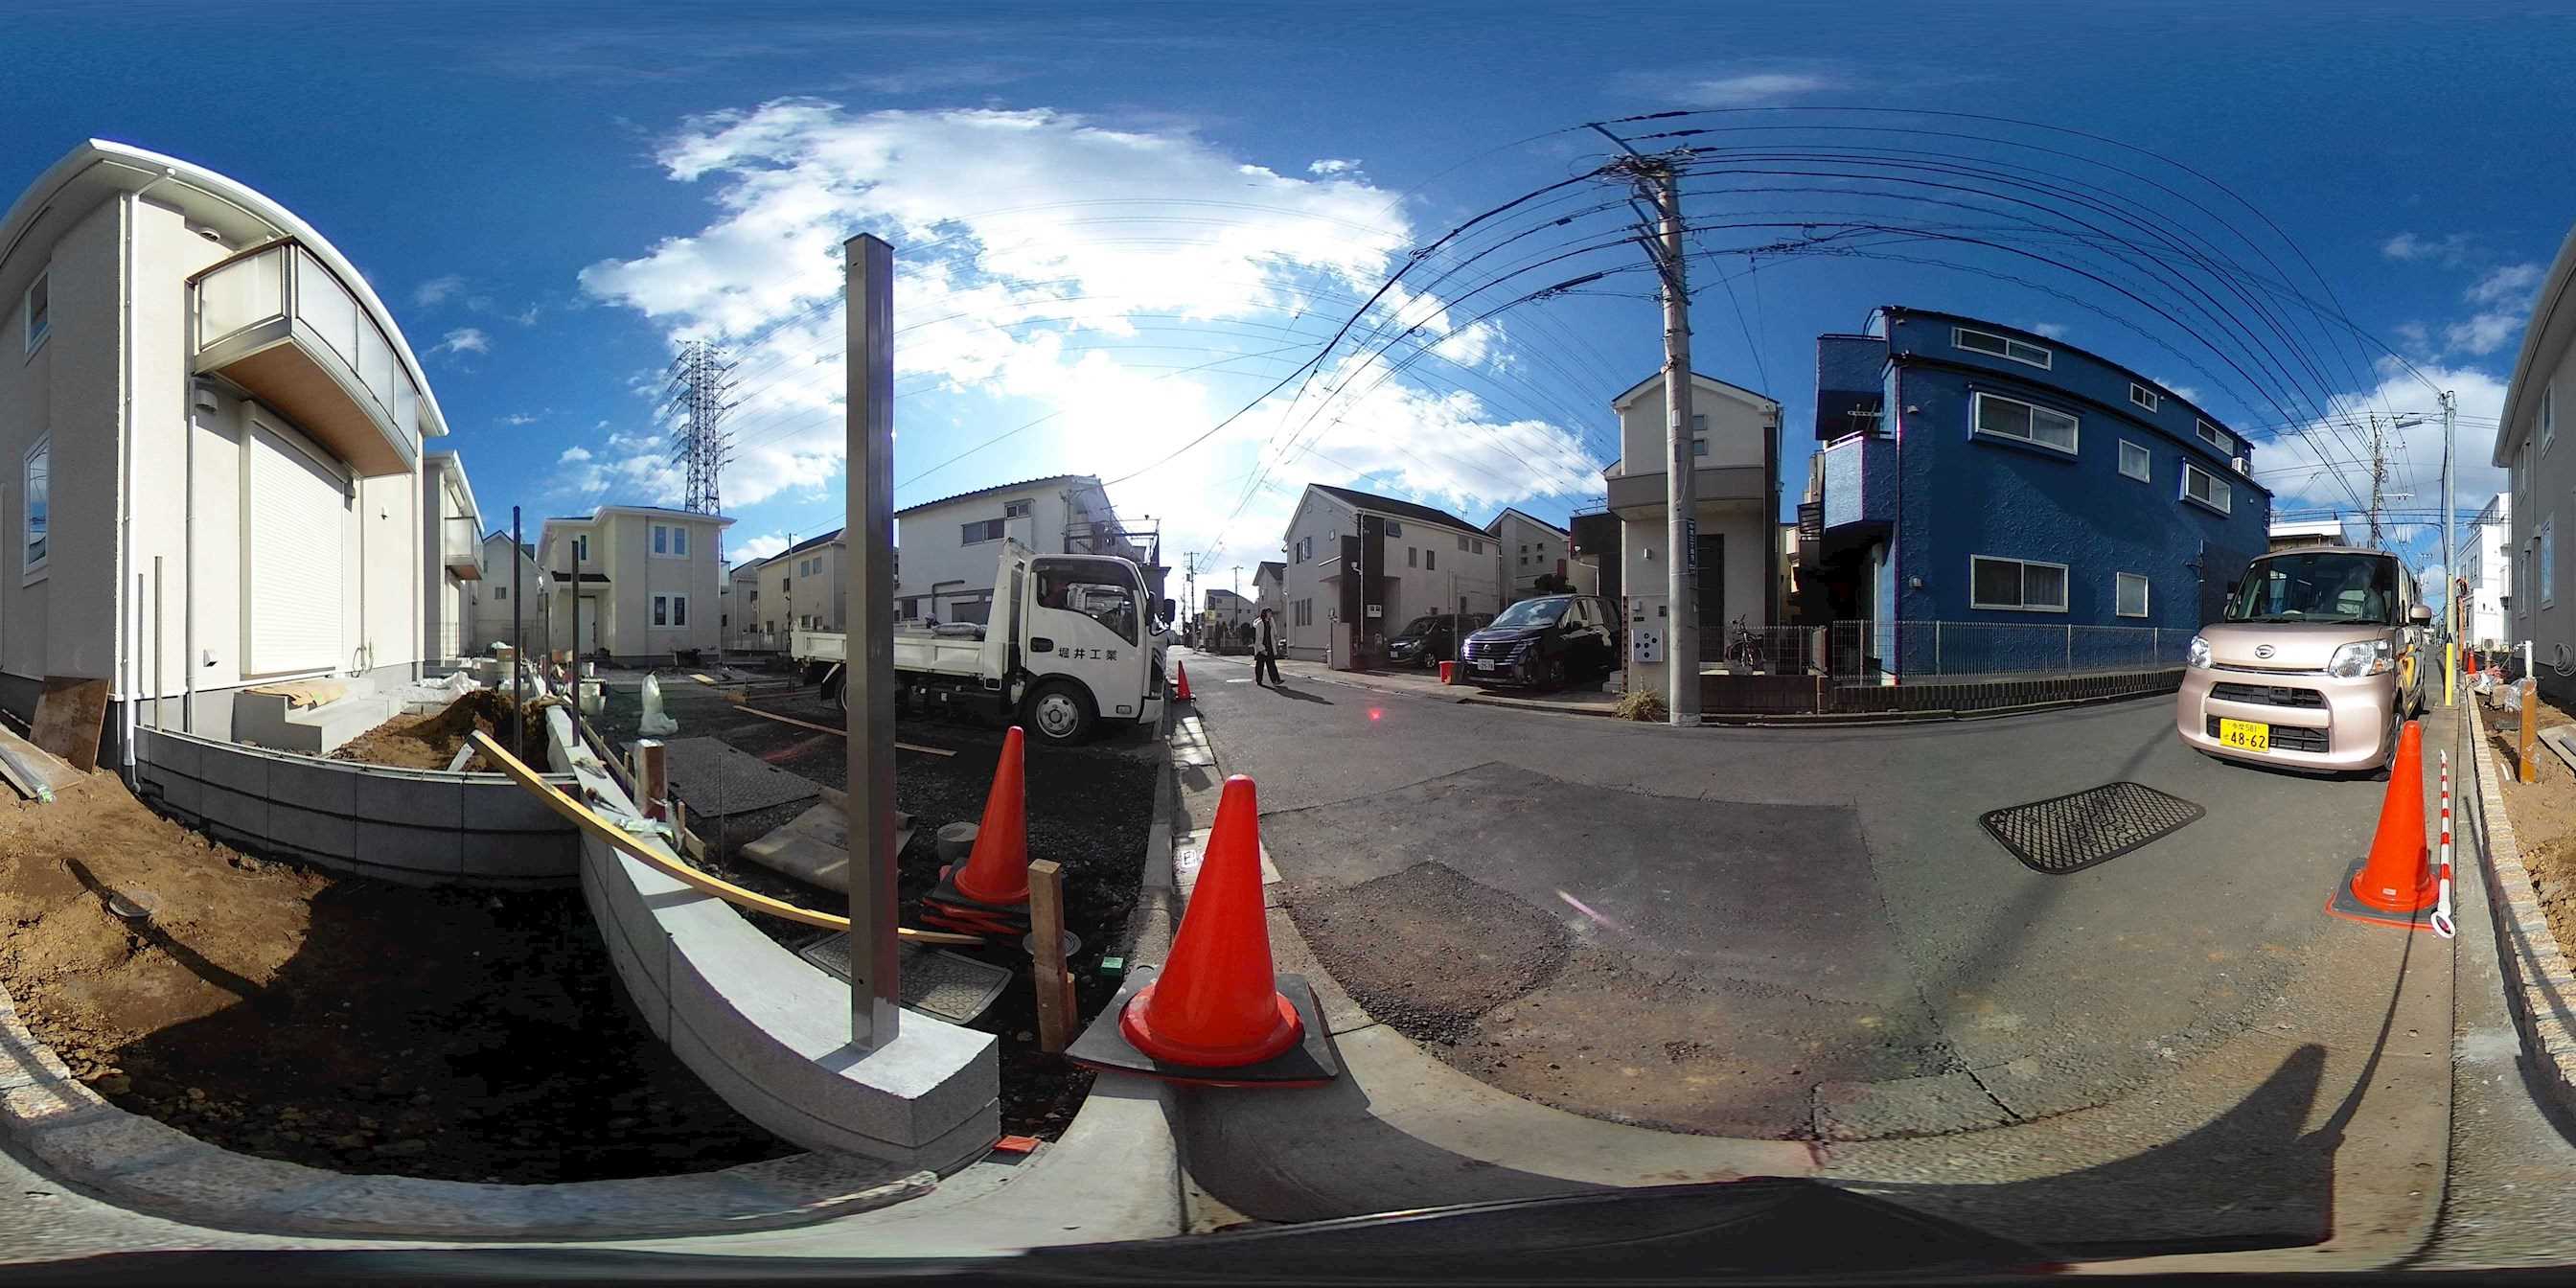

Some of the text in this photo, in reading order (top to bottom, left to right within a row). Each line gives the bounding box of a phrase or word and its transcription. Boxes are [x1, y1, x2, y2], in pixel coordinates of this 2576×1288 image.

[1058, 647, 1117, 661] 堀井工業
[2231, 731, 2266, 748] 48-62
